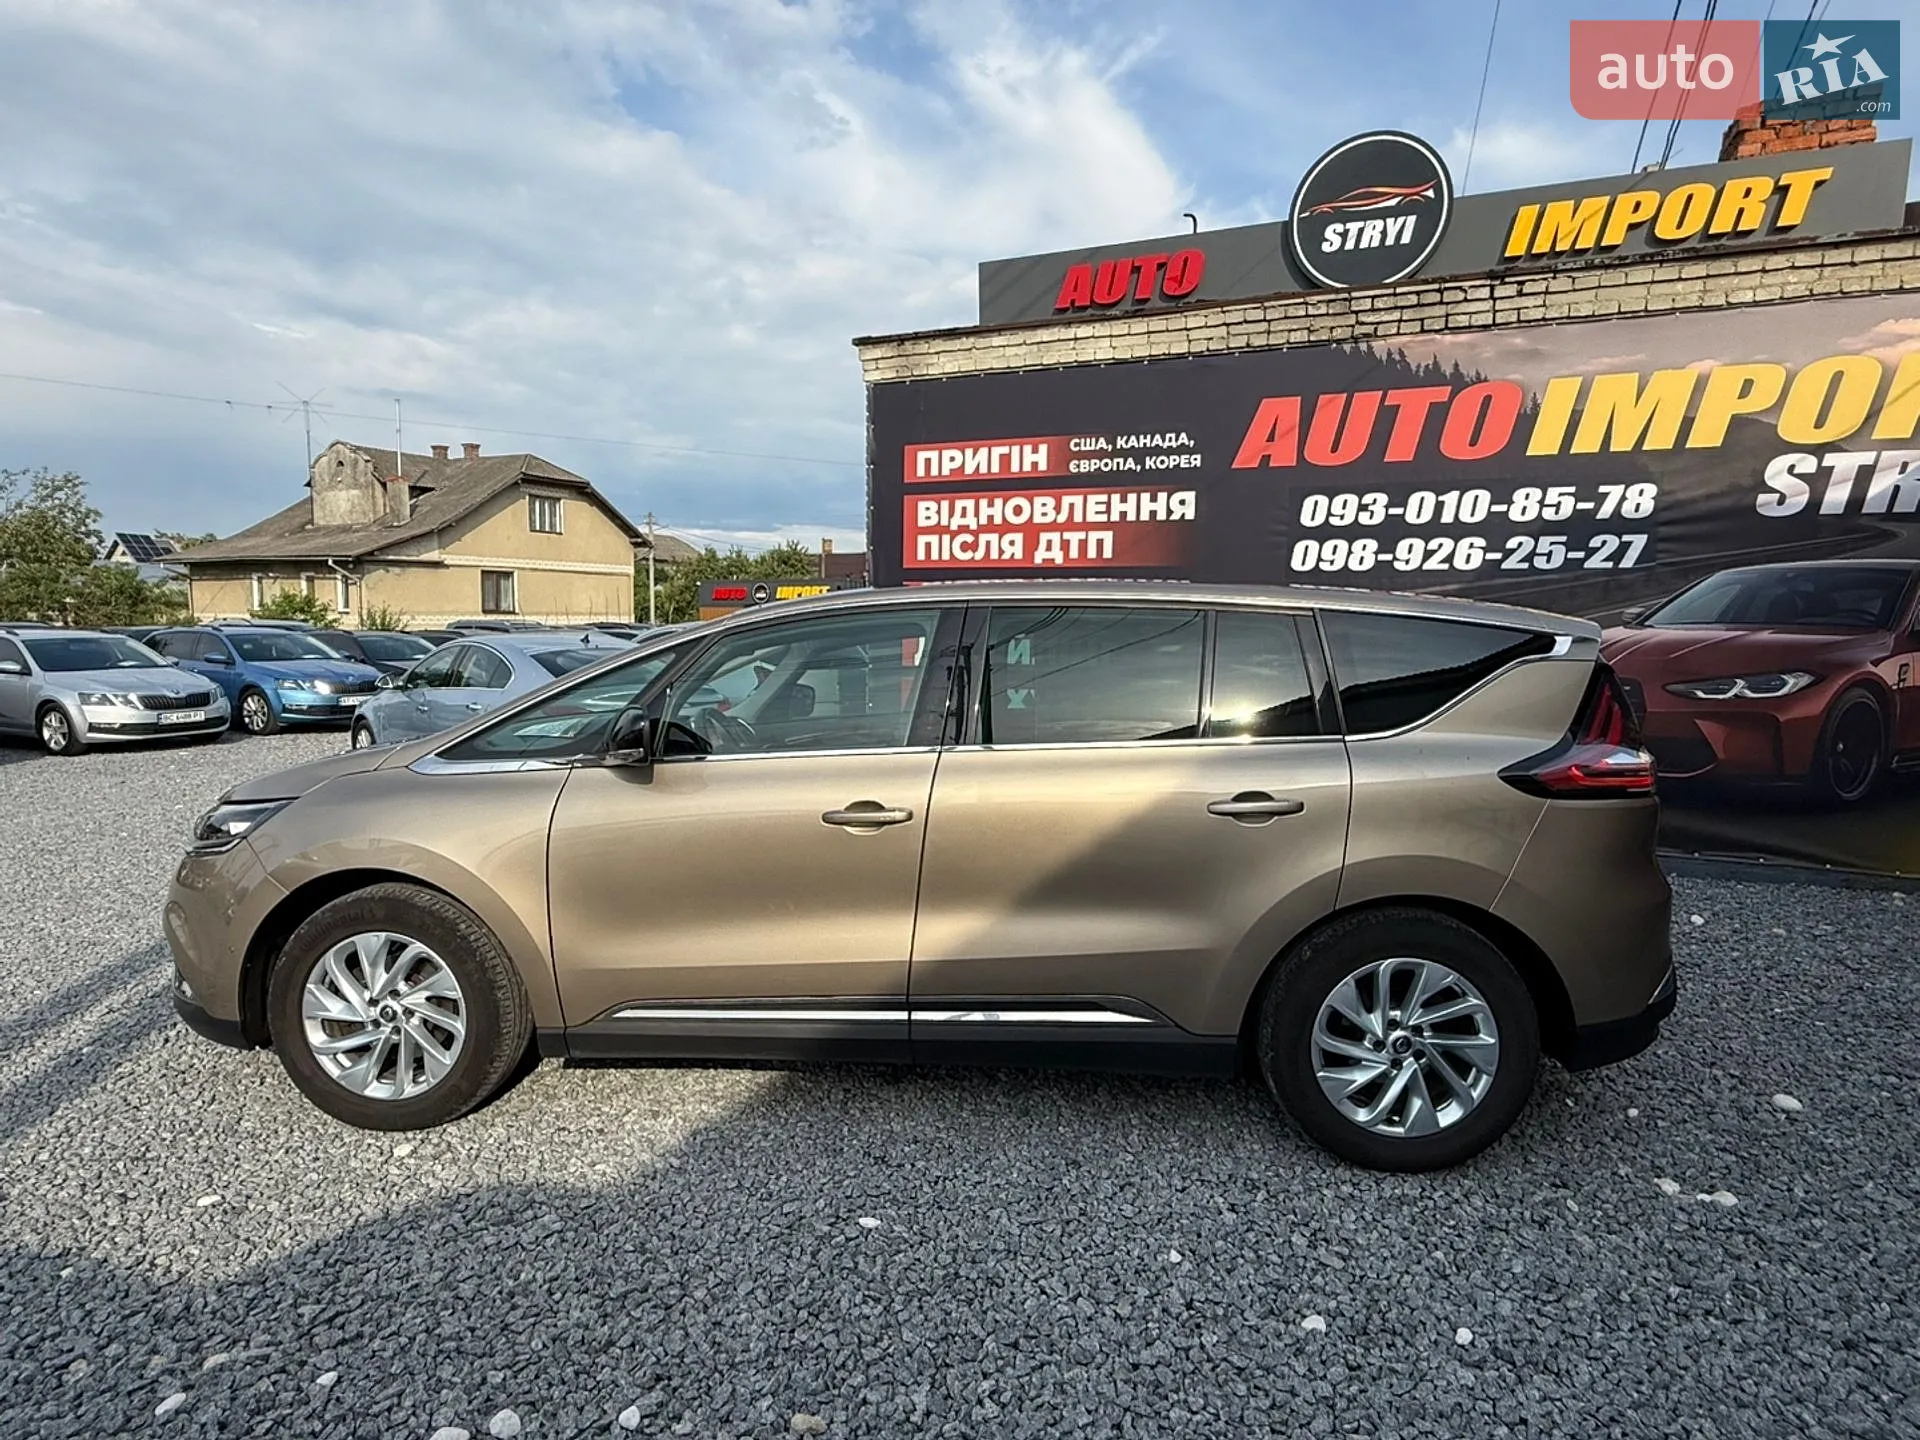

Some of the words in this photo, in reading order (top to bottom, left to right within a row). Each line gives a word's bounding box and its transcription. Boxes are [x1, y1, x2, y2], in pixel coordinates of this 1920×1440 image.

[1504, 166, 1834, 258] IMPORT
[1321, 214, 1417, 253] STRYI
[1054, 248, 1206, 311] AUTO
[916, 443, 1048, 478] ПРИГІН
[1069, 438, 1113, 453] США,
[1116, 432, 1195, 450] КАНАДА,
[1069, 456, 1141, 474] ЄВРОПА,
[1145, 454, 1202, 471] КОРЕЯ
[917, 490, 1196, 531] ВІДНОВЛЕННЯ
[1300, 482, 1658, 528] 093-010-85-78
[917, 532, 1024, 561] ПІСЛЯ
[1034, 530, 1113, 564] ДТП
[1291, 534, 1648, 572] 098-926-25-27
